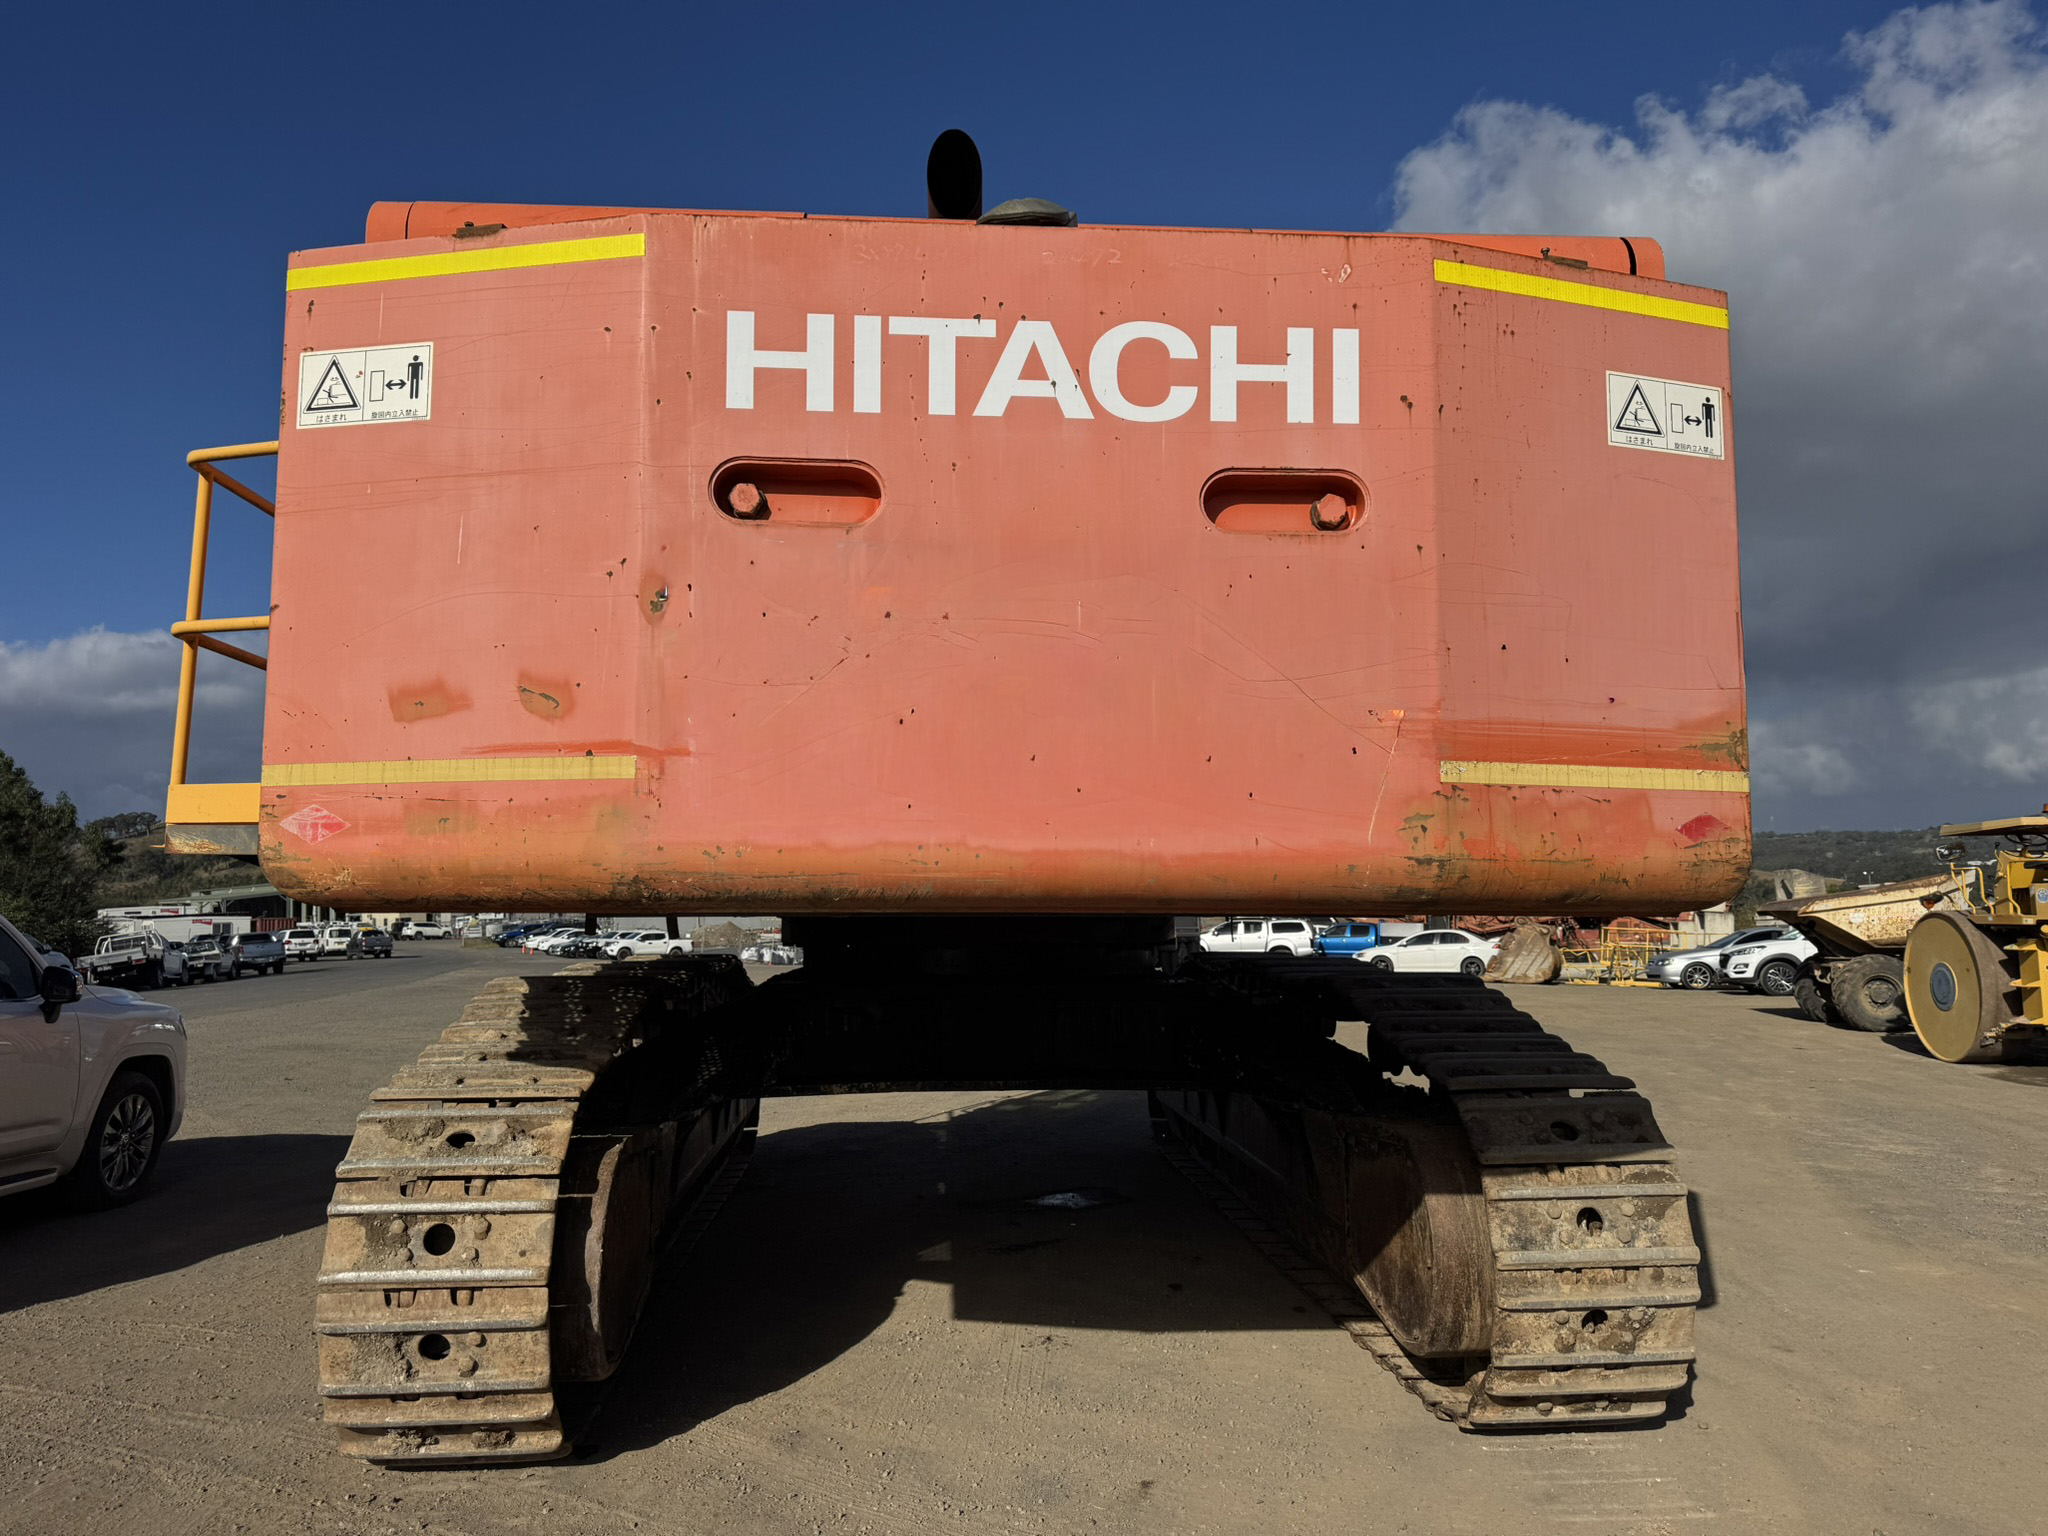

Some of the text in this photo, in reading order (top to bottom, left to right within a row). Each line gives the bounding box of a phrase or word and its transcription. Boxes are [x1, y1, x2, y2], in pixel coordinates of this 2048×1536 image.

[725, 310, 1360, 424] HITACHI
[316, 413, 347, 423] はさまれ
[1625, 435, 1654, 446] はさまれ
